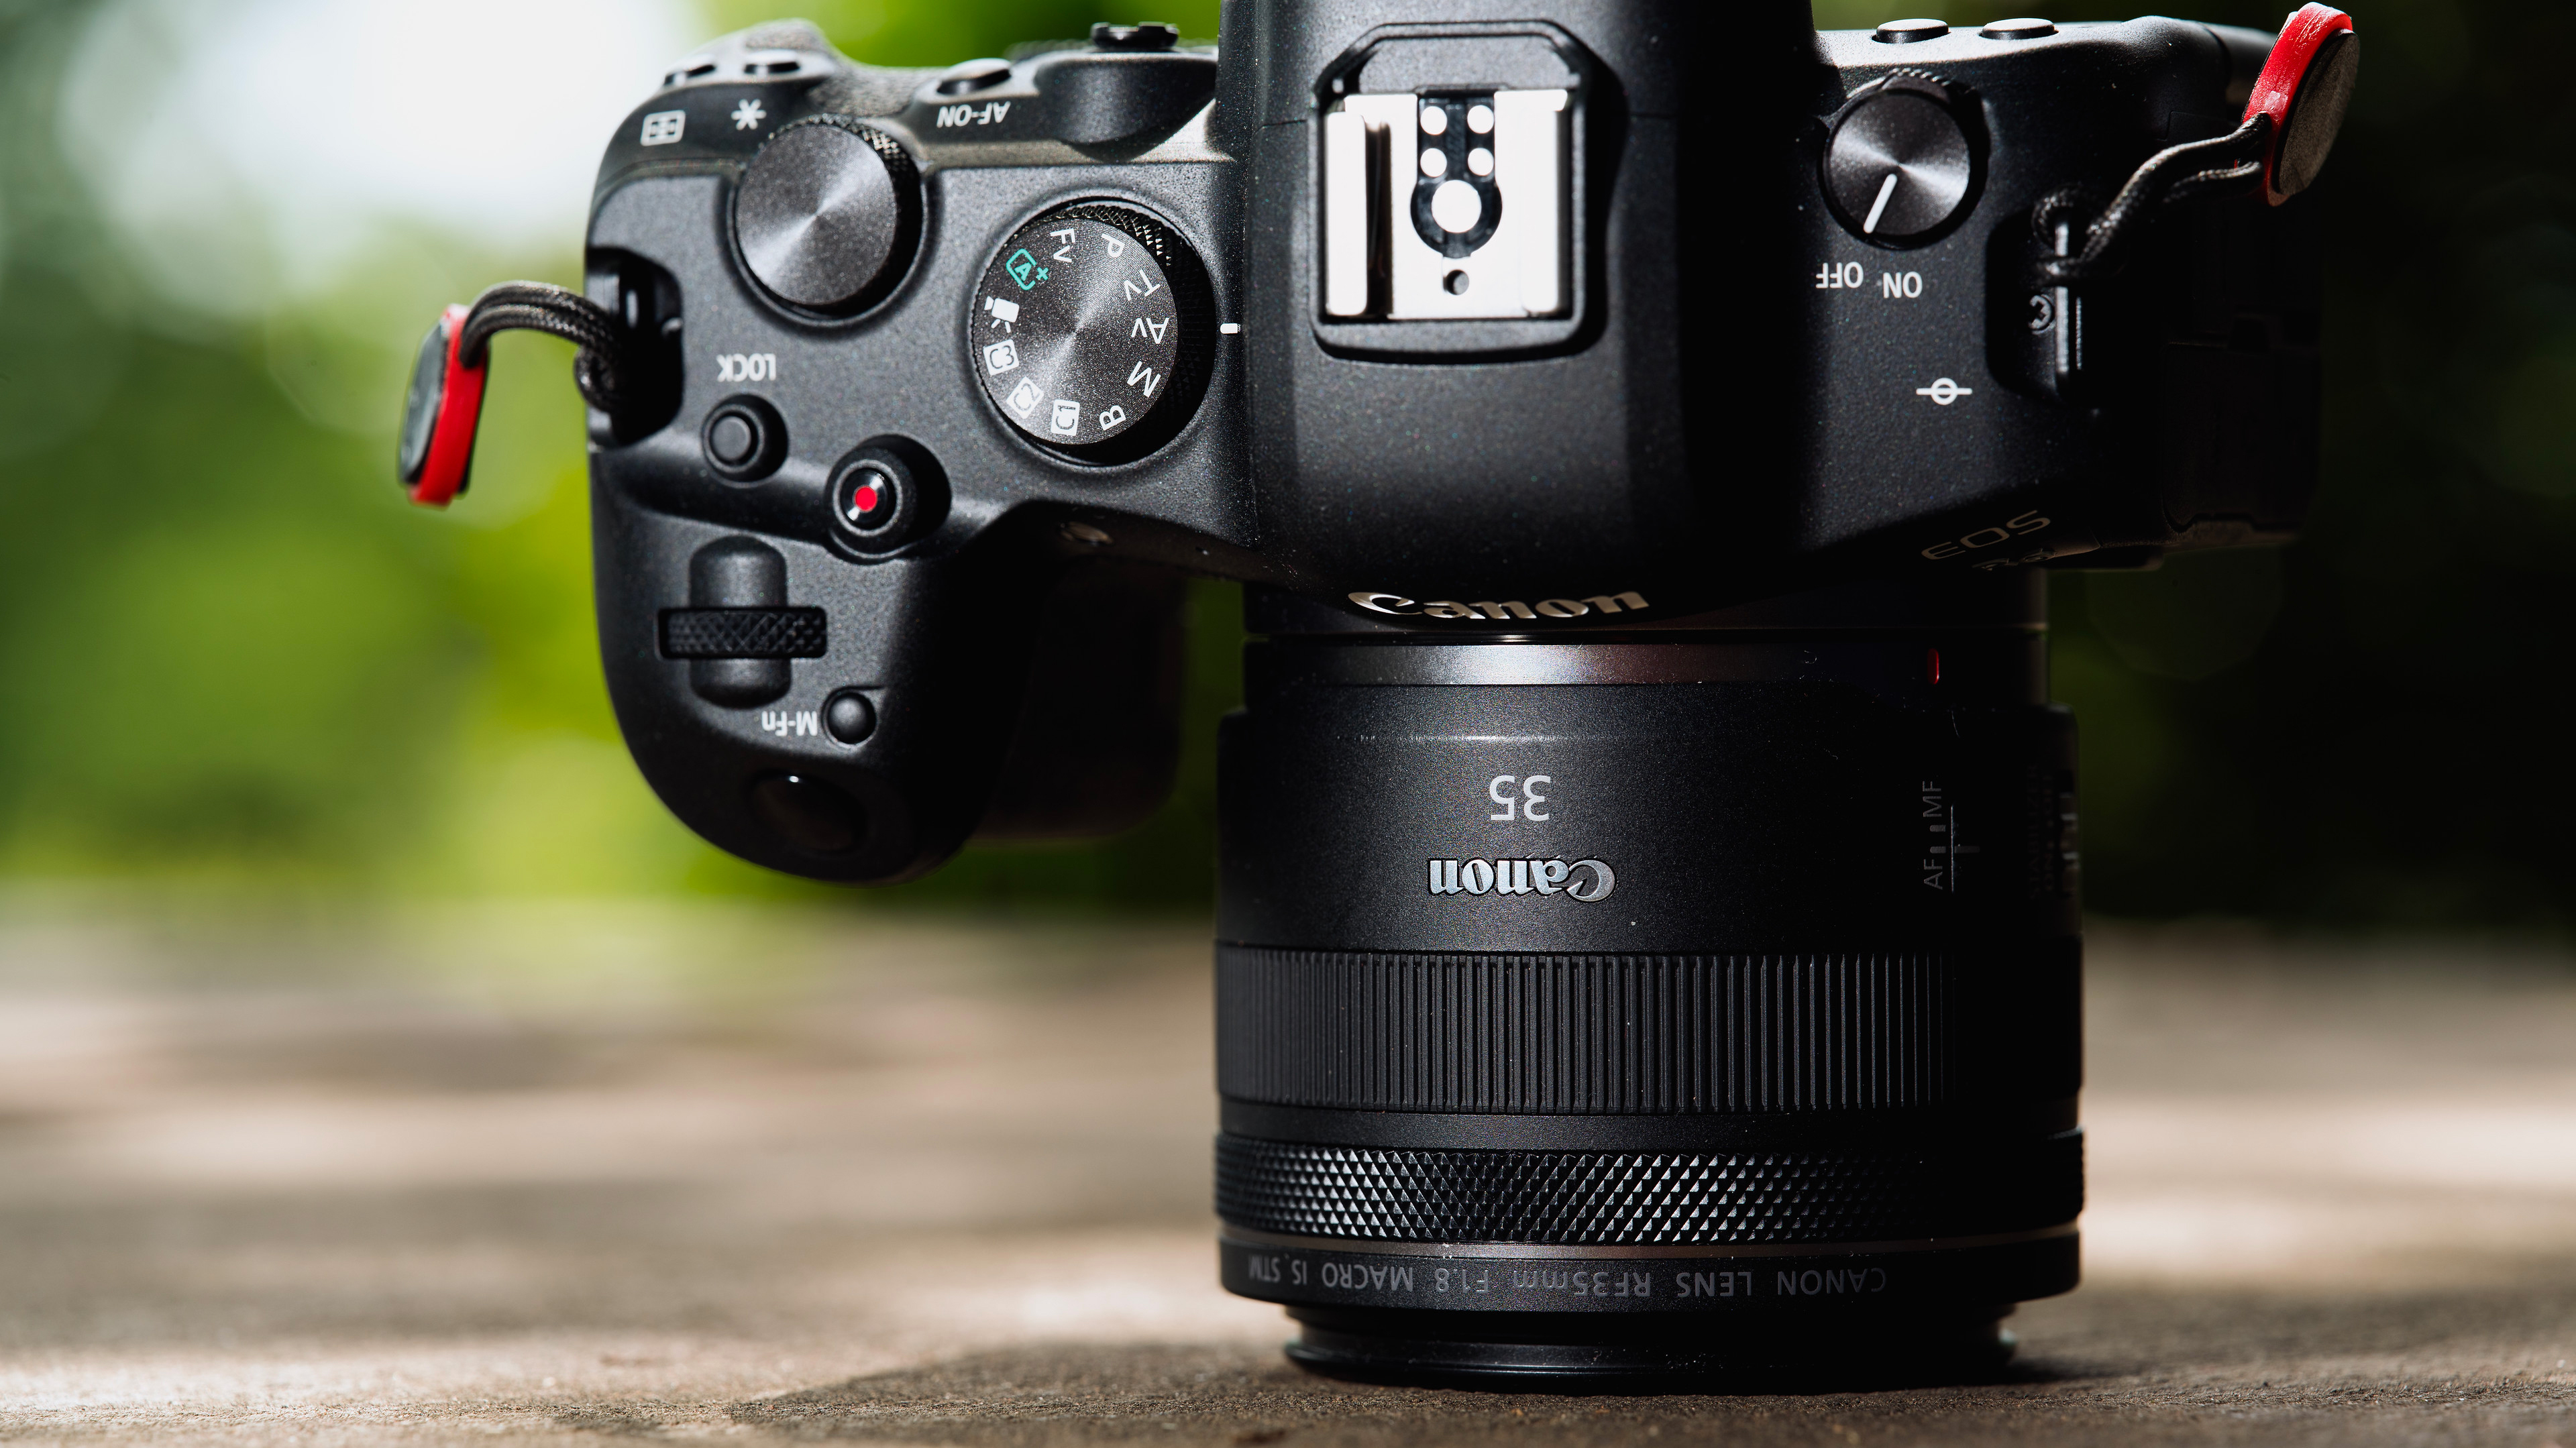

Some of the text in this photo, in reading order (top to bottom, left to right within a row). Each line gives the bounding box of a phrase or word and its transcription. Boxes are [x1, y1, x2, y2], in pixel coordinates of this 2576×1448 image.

[936, 101, 1011, 128] AF-ON
[1050, 228, 1076, 263] Fv
[1101, 233, 1125, 258] P
[1124, 269, 1161, 301] Tv
[1815, 262, 1864, 289] OFF
[1882, 271, 1923, 299] ON
[1131, 317, 1169, 344] Av
[716, 353, 776, 382] LOCK
[989, 344, 1014, 370] C3
[1127, 361, 1161, 398] M
[1013, 382, 1038, 410] C2
[1055, 404, 1077, 430] C1
[1099, 404, 1126, 431] B
[1921, 510, 2051, 560] EOS
[1348, 591, 1650, 620] Canon
[761, 710, 819, 737] M-Fn
[1489, 775, 1551, 821] 35
[1922, 780, 1943, 891] AF MF
[1428, 856, 1617, 903] Canon
[1248, 1254, 1887, 1298] CANON LENS RF35mm F1.8 MACRO IS STM
